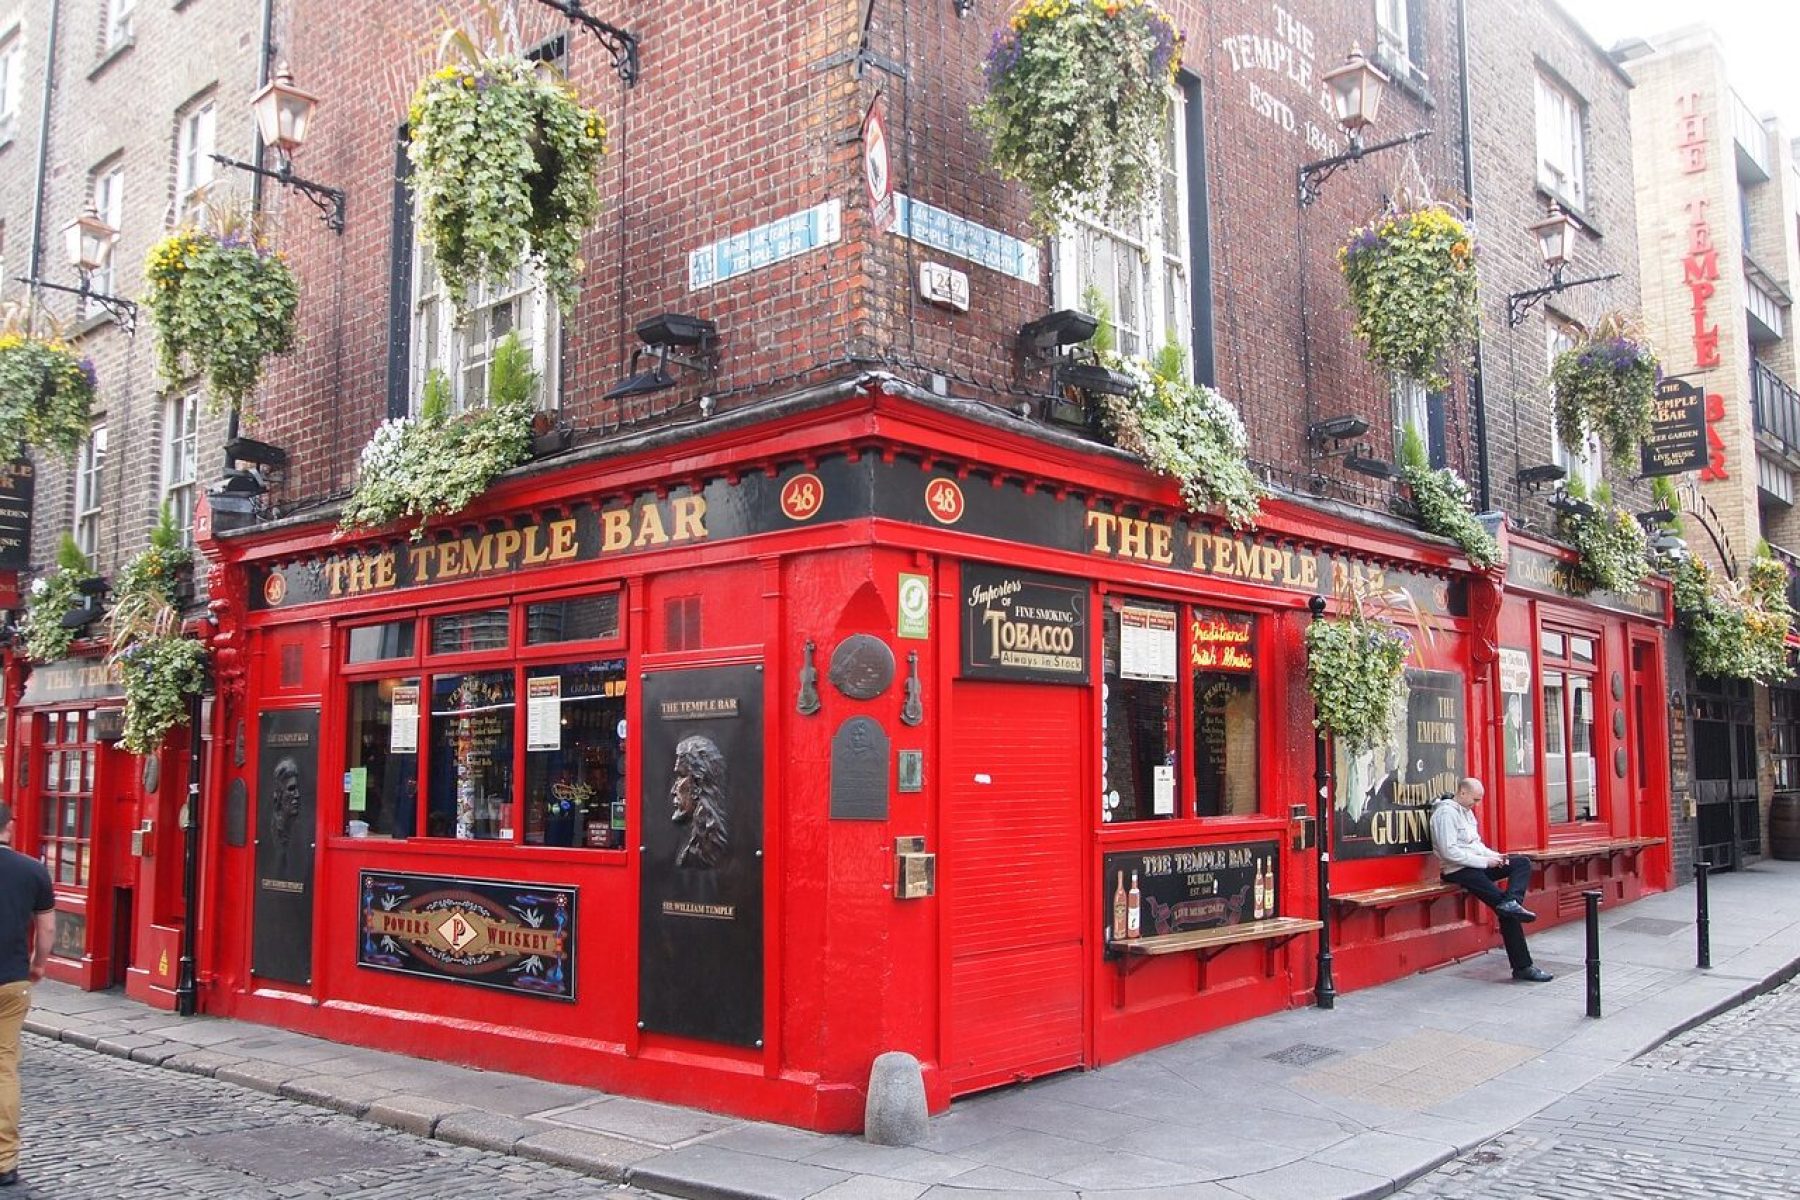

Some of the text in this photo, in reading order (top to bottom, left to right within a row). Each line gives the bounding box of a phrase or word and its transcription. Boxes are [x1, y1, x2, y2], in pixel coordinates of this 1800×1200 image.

[1273, 4, 1315, 60] THE
[1222, 34, 1312, 96] TEMPLE
[1675, 92, 1709, 175] THE
[732, 245, 774, 271] TEMPLE
[777, 236, 802, 256] BAR
[1681, 199, 1721, 368] TEMPLE
[1661, 384, 1680, 394] THE
[1658, 409, 1687, 421] BAR
[1667, 430, 1699, 440] GARDEN
[787, 483, 815, 512] 48
[931, 484, 956, 513] 48
[325, 493, 708, 595] THE TEMPLE BAR
[1087, 510, 1174, 564] THE
[1188, 530, 1318, 589] TEMPLE
[968, 580, 1022, 609] Importers
[1001, 597, 1012, 607] OF
[1014, 605, 1073, 623] FINE SMOKING
[982, 609, 1074, 660] TOBACCO
[1191, 621, 1250, 642] Traditional
[1003, 655, 1081, 669] Always in Stock
[1221, 646, 1253, 669] Music
[661, 698, 737, 713] THE TEMPLE BAR
[1438, 697, 1456, 719] THE
[1416, 720, 1456, 745] EMPEROR
[1371, 809, 1431, 845] GUINN
[1143, 847, 1254, 877] THE TEMPLE BAR
[1187, 873, 1214, 886] DUBLIN
[674, 902, 705, 914] WILLIAM
[705, 905, 734, 916] TEMPLE
[383, 914, 548, 950] POWERS P WHISKEY
